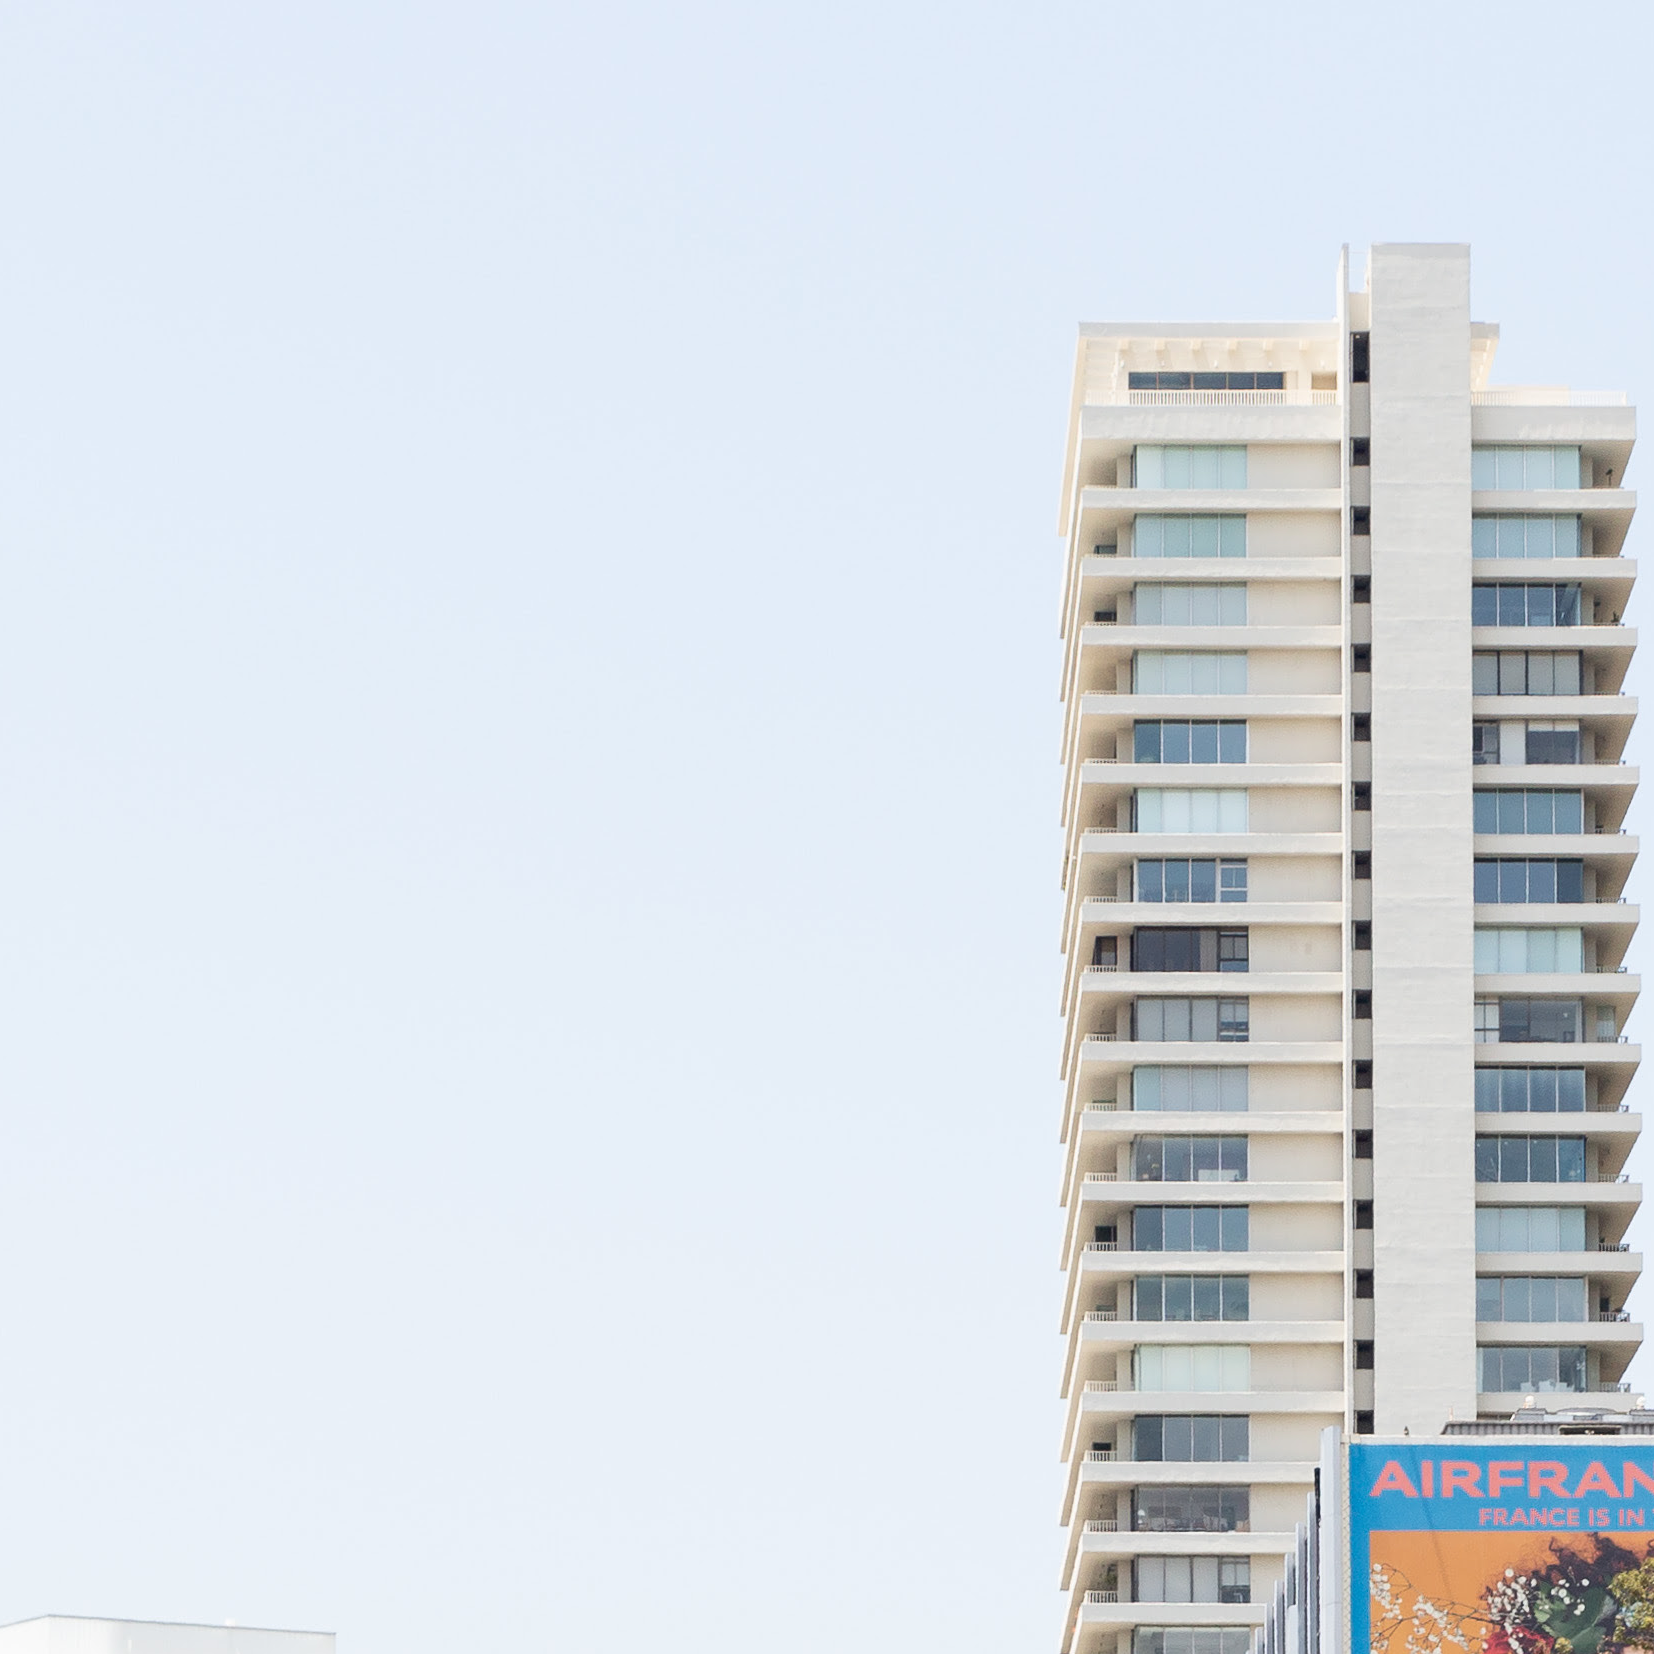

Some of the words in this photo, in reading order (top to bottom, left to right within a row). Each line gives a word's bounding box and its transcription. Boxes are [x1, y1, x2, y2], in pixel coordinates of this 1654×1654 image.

[1479, 1508, 1580, 1527] FRANCE
[1588, 1508, 1610, 1527] IS
[1619, 1508, 1645, 1527] IN
